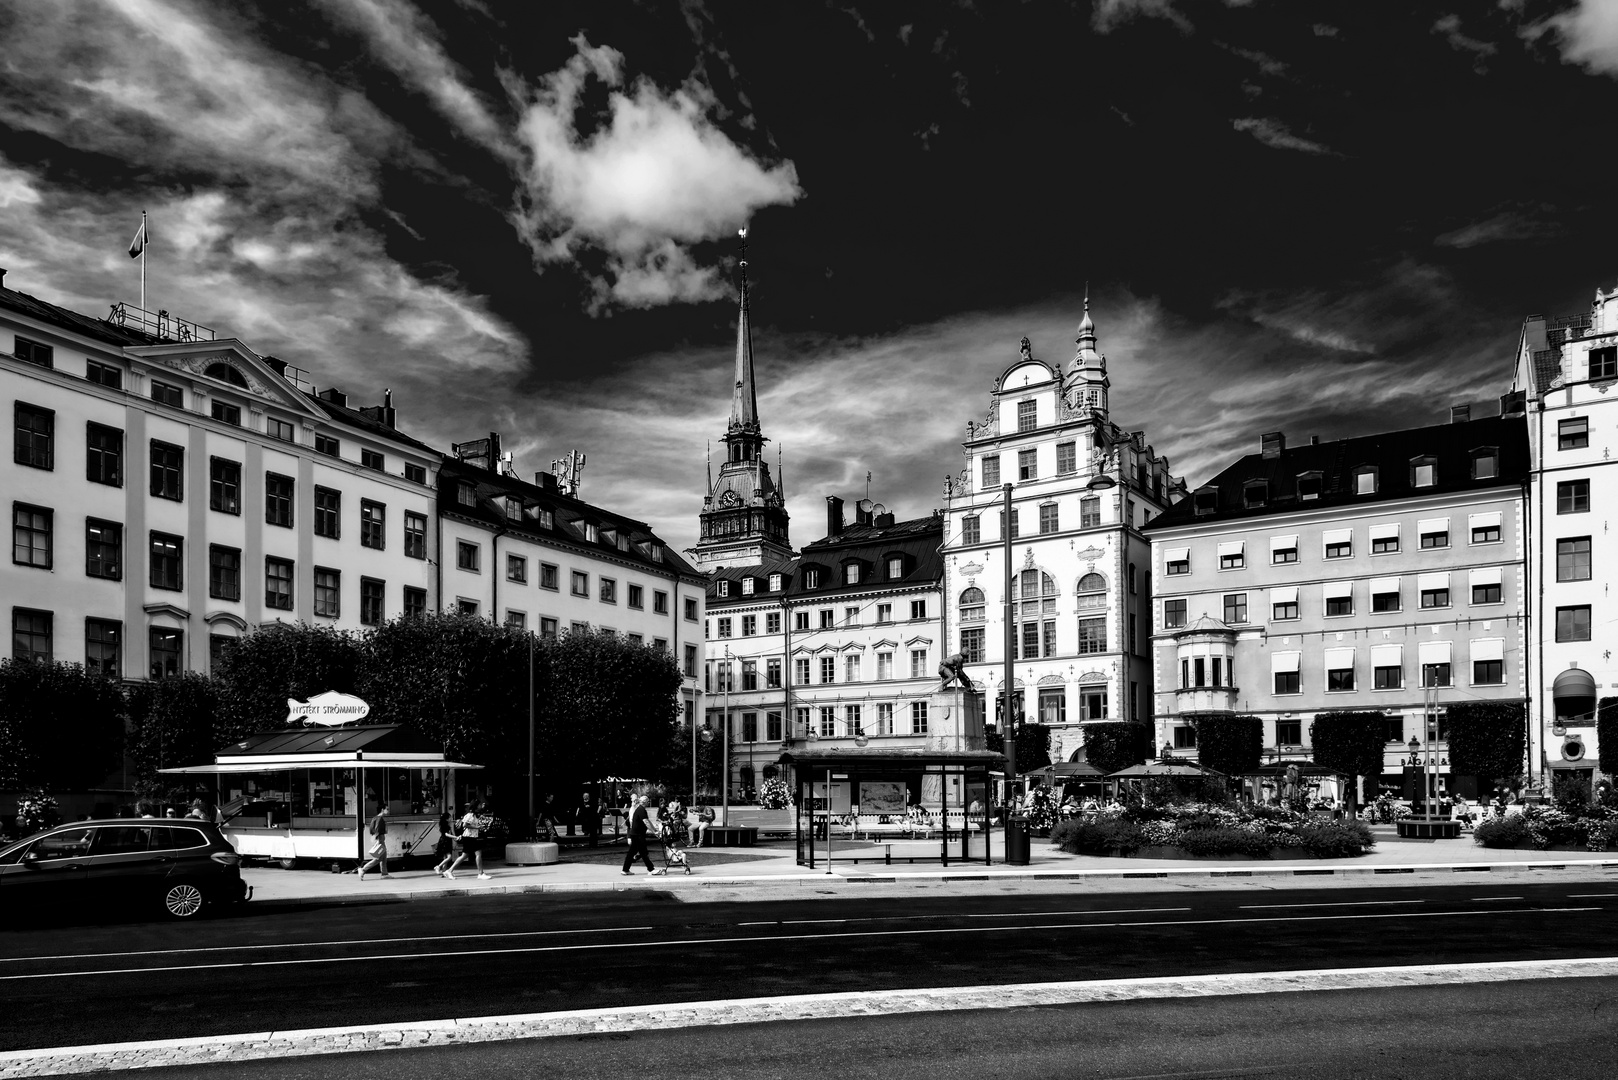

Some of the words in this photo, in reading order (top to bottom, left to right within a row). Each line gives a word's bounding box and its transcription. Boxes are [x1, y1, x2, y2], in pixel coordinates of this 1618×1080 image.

[292, 706, 320, 714] NYSTEKT
[323, 704, 366, 714] STRÖMMING
[1440, 758, 1447, 766] &
